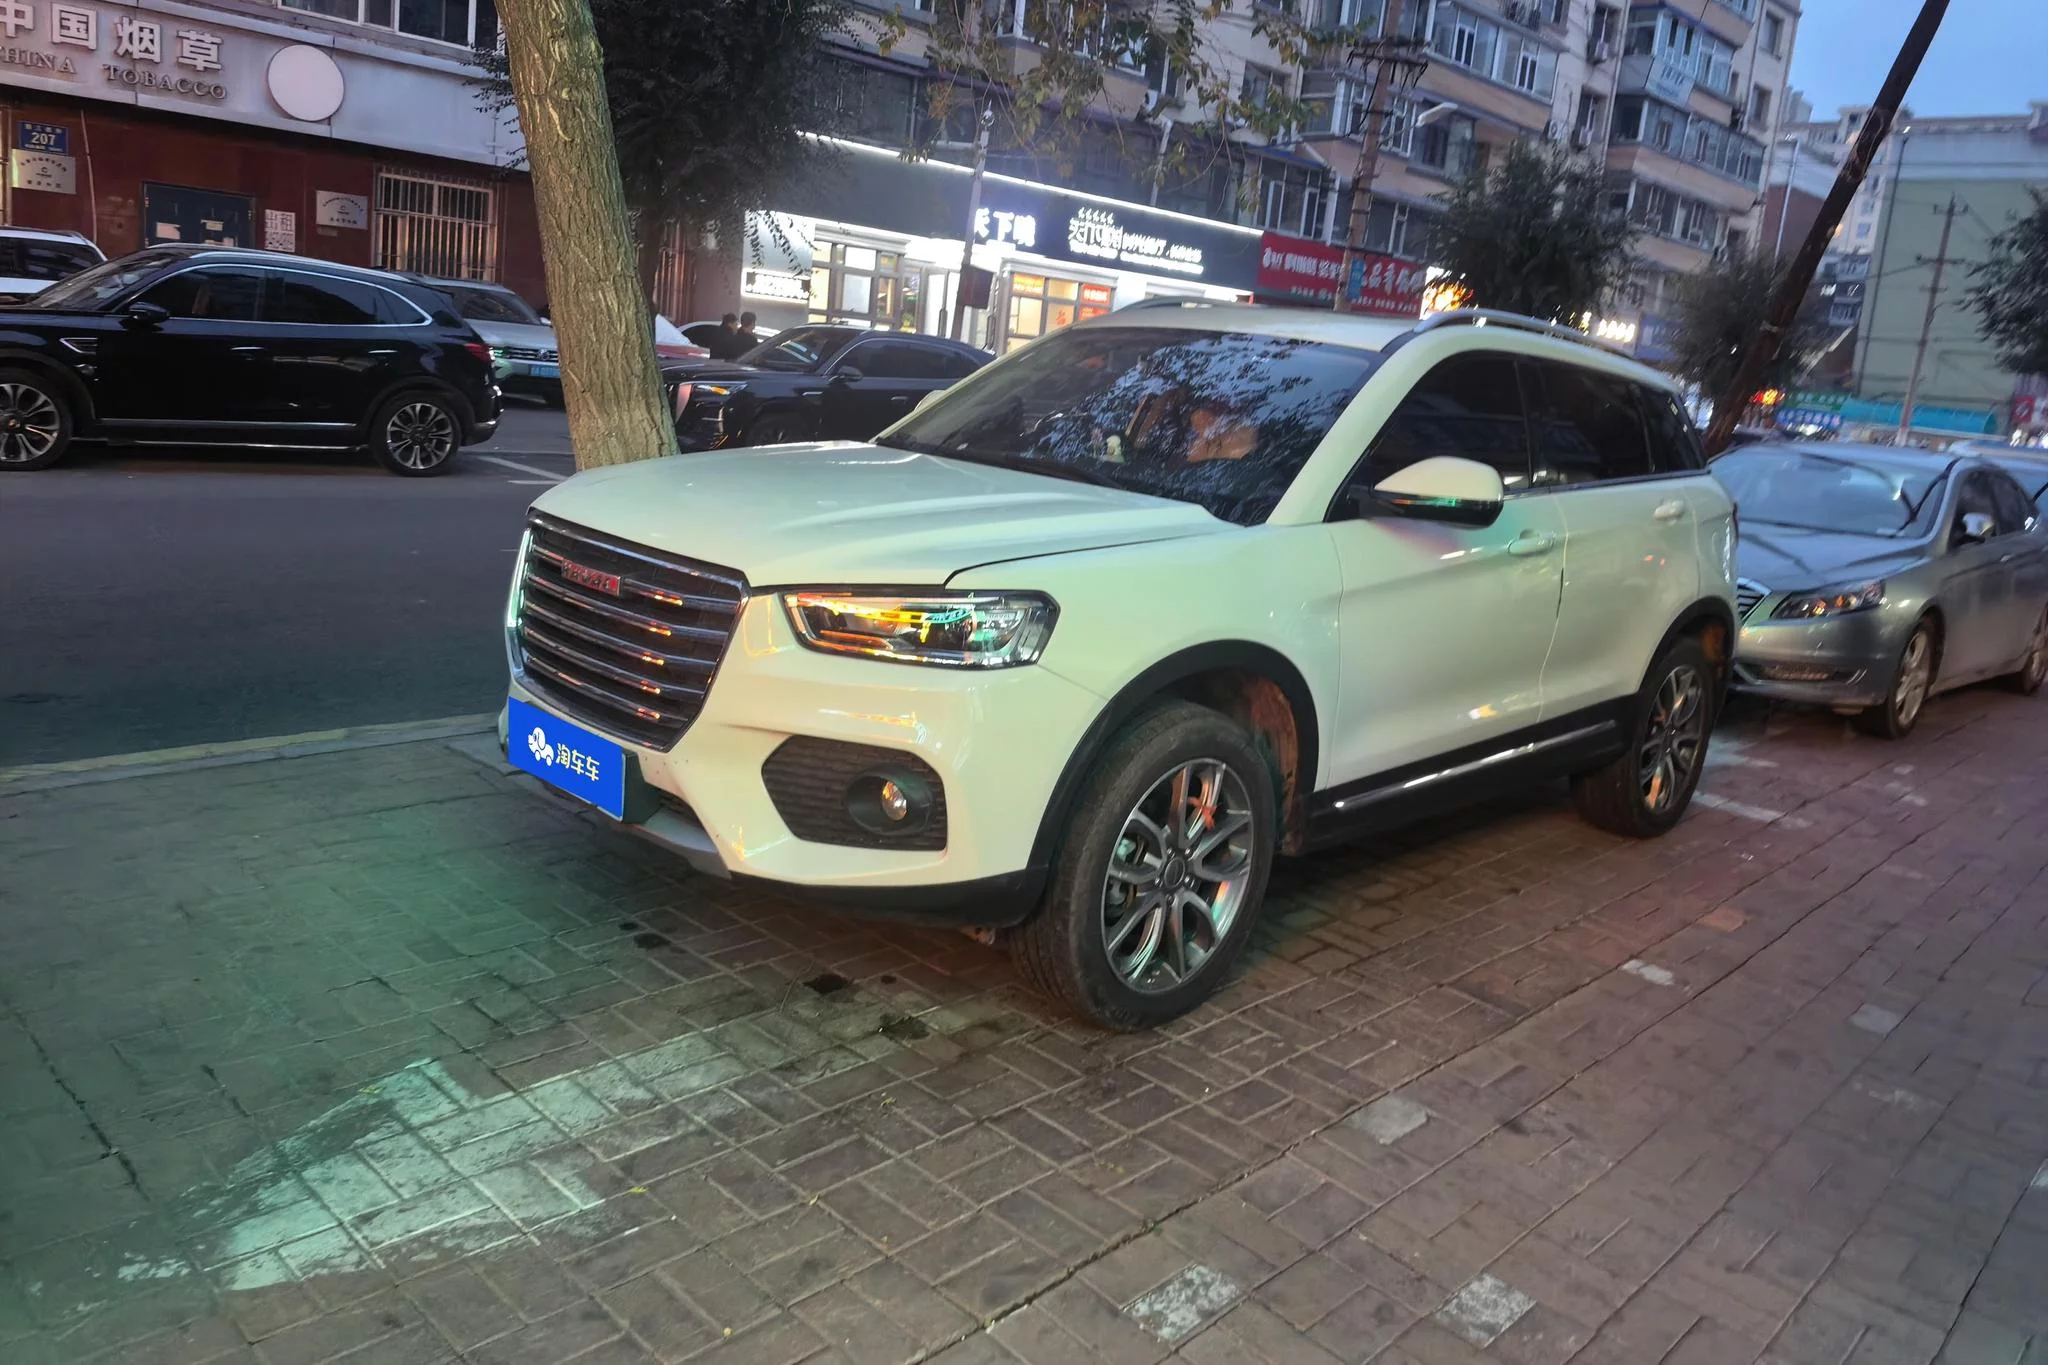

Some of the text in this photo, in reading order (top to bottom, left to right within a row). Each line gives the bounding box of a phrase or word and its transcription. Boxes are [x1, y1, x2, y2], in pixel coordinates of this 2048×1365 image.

[0, 0, 222, 72] 中国烟草
[0, 46, 77, 74] HINA
[102, 63, 227, 99] TOBACCO
[31, 131, 56, 146] 207
